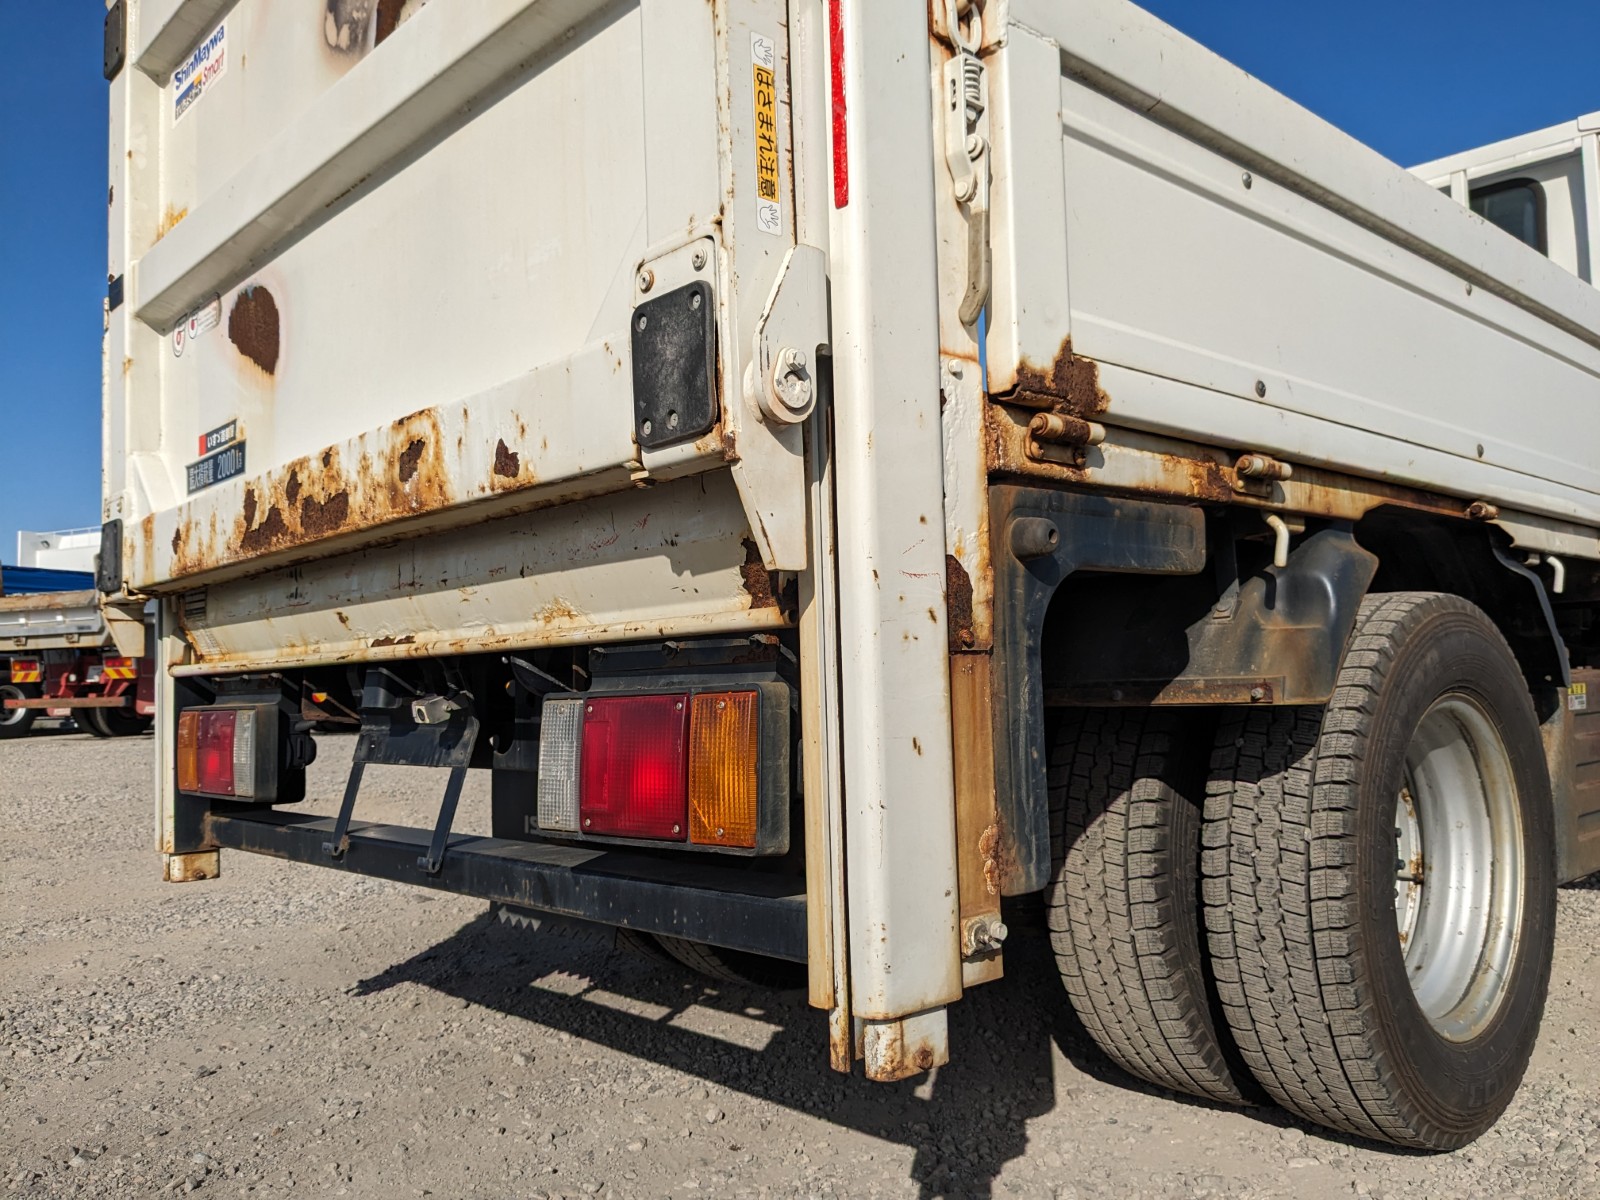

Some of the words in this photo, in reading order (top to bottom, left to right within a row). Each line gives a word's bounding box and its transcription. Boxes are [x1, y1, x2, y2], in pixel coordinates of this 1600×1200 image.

[175, 25, 224, 90] ShinMaywa
[757, 67, 776, 200] はさまれ注意
